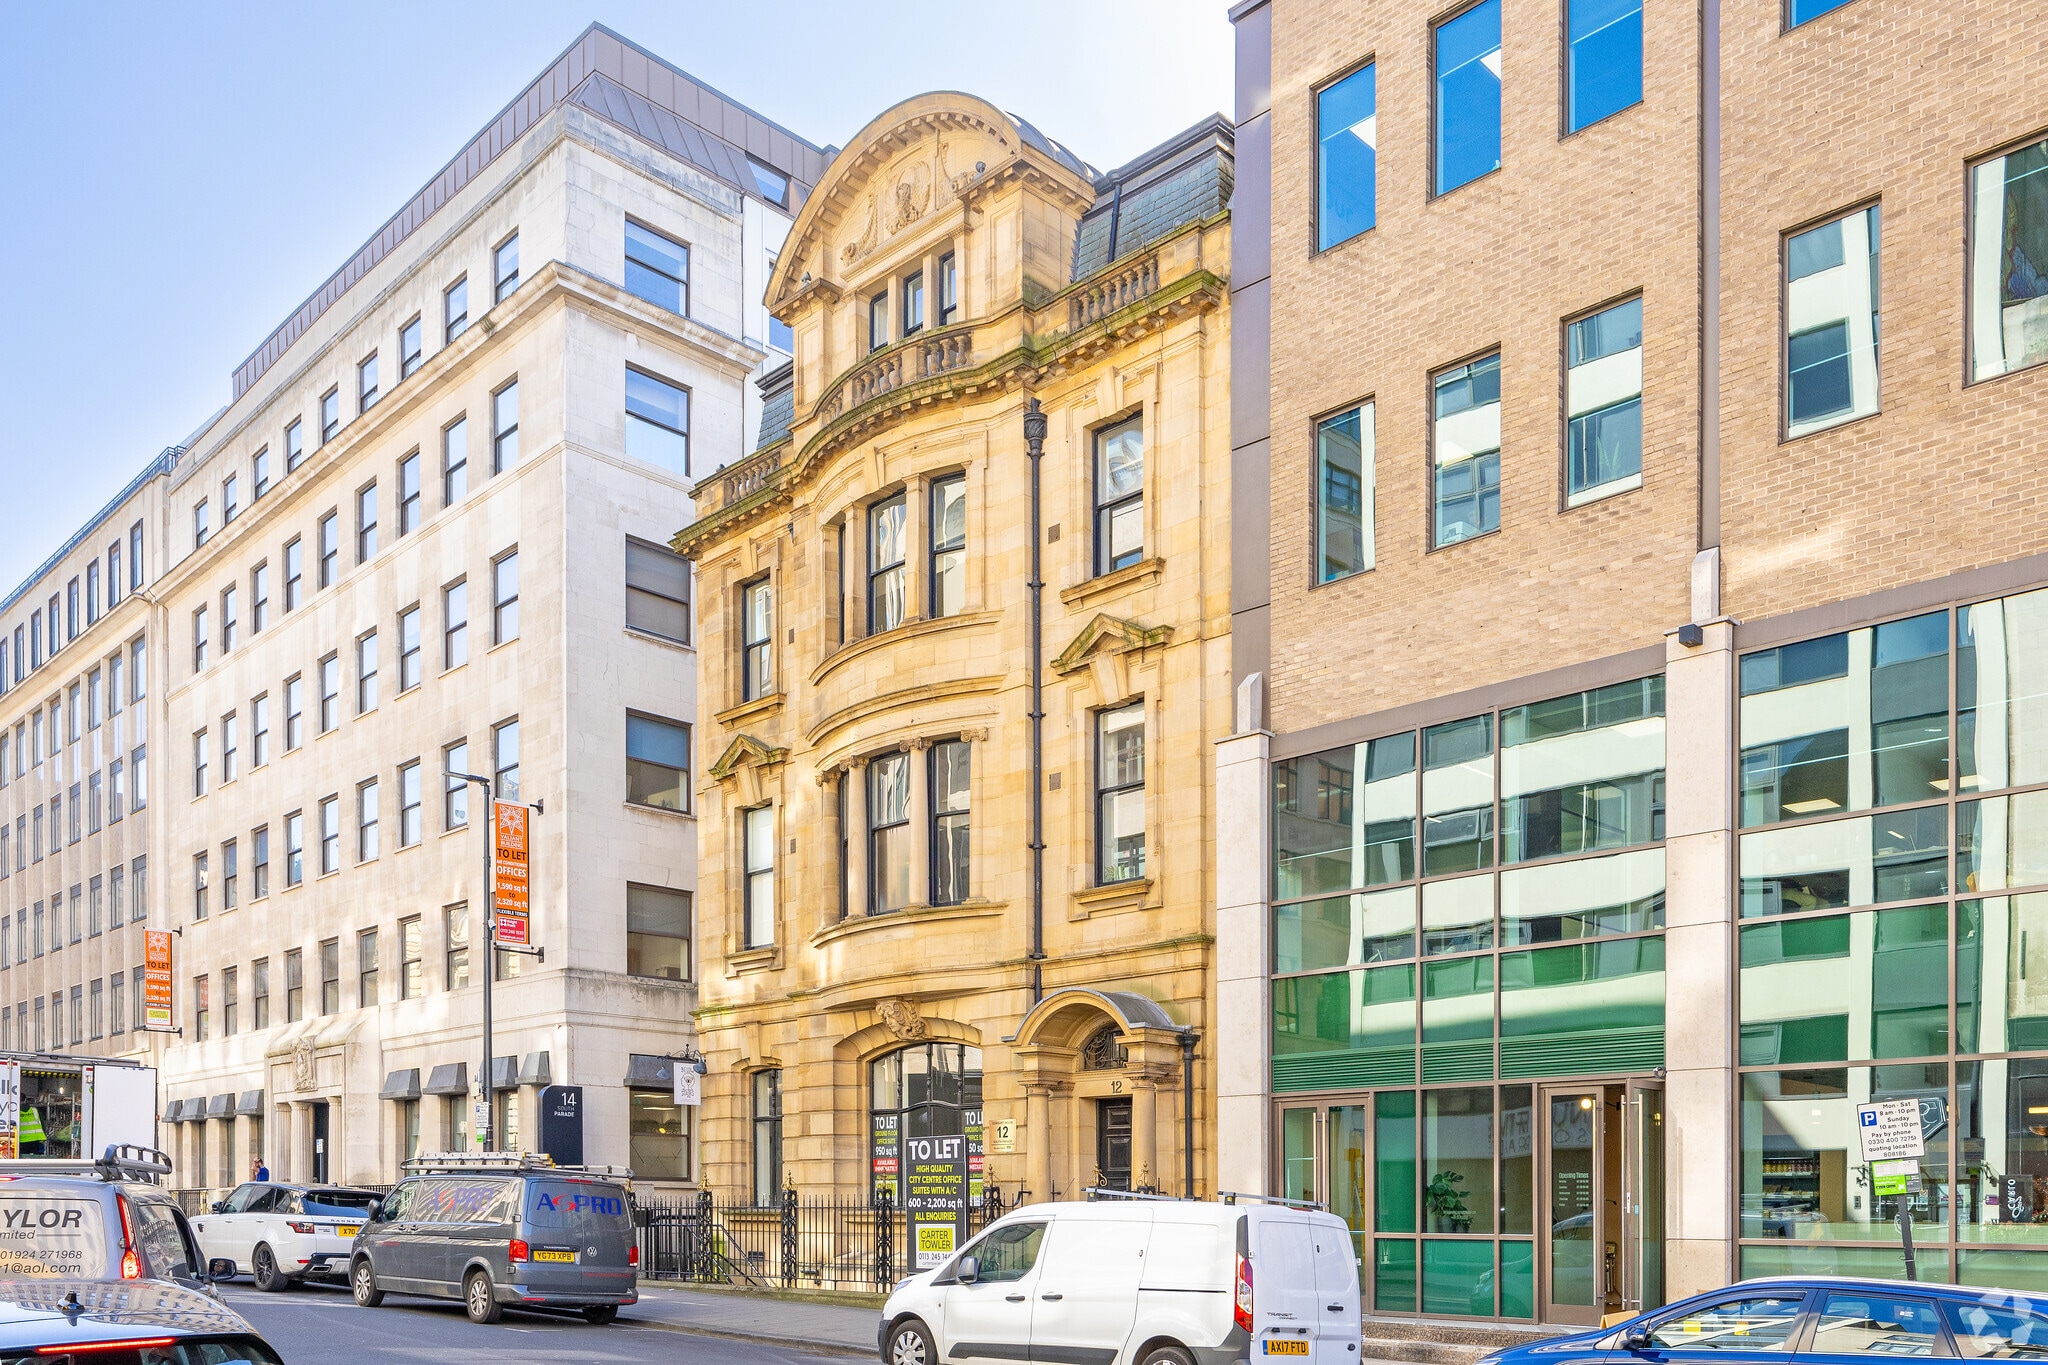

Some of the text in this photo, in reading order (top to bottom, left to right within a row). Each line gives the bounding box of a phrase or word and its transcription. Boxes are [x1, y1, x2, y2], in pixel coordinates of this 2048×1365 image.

[497, 848, 526, 860] TO LET
[497, 866, 526, 878] OFFICES
[514, 885, 520, 893] sq
[1111, 1081, 1122, 1093] 12
[561, 1093, 576, 1106] 14
[876, 1116, 897, 1129] TO LET
[965, 1112, 976, 1124] TO
[997, 1126, 1008, 1138] 12
[876, 1146, 898, 1157] 950 sq ft
[909, 1139, 960, 1160] TO LET
[930, 1164, 953, 1173] QUALITY
[943, 1176, 962, 1184] OFFICE
[908, 1198, 921, 1208] 600
[928, 1198, 946, 1210] 2,200
[948, 1200, 956, 1210] sq
[957, 1198, 963, 1208] ft
[4, 1209, 82, 1228] YLOR
[915, 1212, 956, 1220] ALL ENQUIRIES
[921, 1230, 948, 1239] CARTER
[921, 1240, 951, 1249] TOWLER
[40, 1250, 82, 1259] 271968
[1271, 1342, 1305, 1352] AX17 FTD
